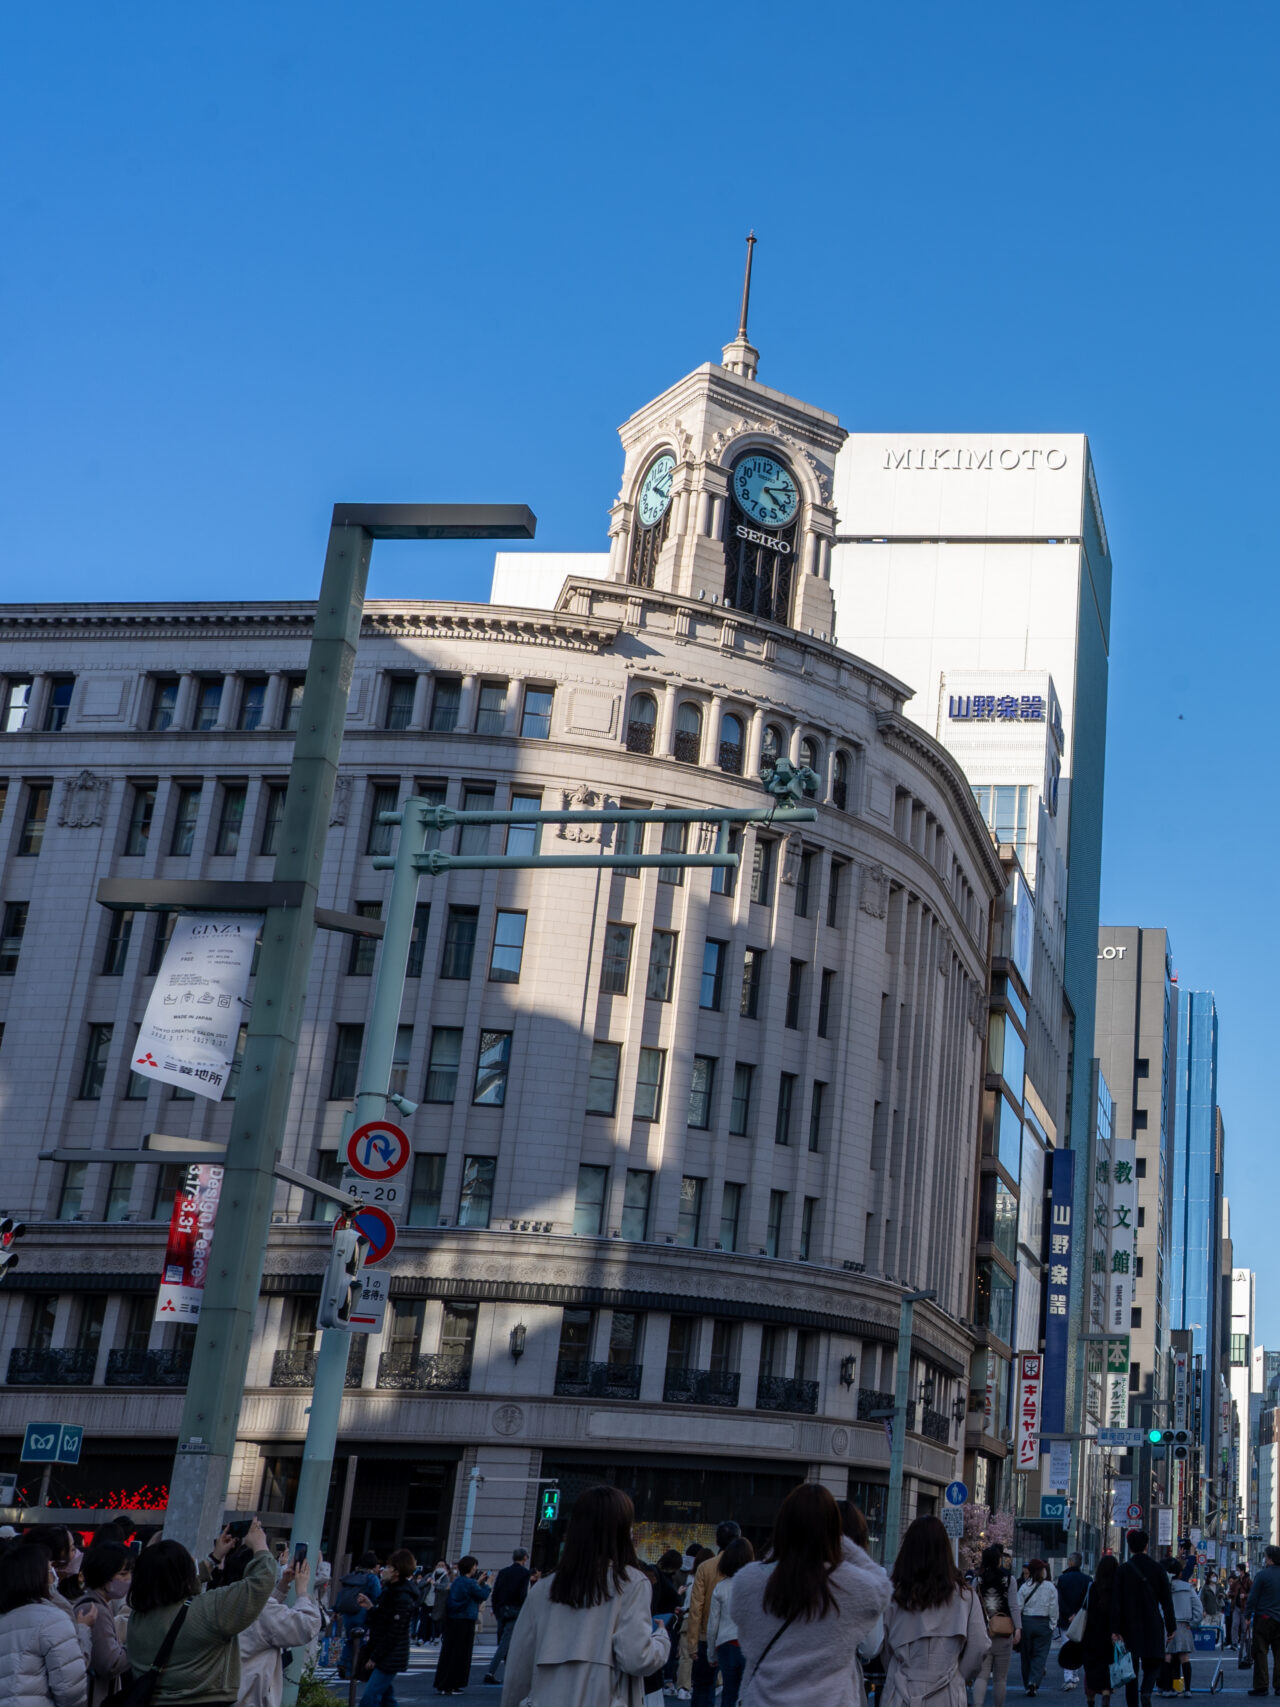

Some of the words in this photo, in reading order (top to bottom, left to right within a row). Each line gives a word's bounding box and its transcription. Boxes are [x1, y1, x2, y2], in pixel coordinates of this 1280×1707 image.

[883, 449, 1067, 470] MIKIMOTO
[743, 466, 753, 478] 10
[753, 461, 761, 473] 11
[763, 462, 773, 475] 12
[776, 470, 780, 480] 1
[739, 476, 747, 487] 9
[741, 489, 750, 500] 8
[784, 493, 792, 504] 3
[750, 500, 758, 511] 7
[759, 507, 767, 518] 6
[770, 508, 778, 519] 5
[736, 525, 791, 554] SEIKO
[949, 695, 1043, 719] 山野楽器
[192, 924, 241, 936] GINZA
[163, 1061, 223, 1086] 三菱地所
[1111, 1160, 1133, 1275] 教文館
[1049, 1204, 1071, 1316] 山野楽器
[1108, 1340, 1127, 1368] 本
[1020, 1384, 1038, 1464] キムラヤのパン
